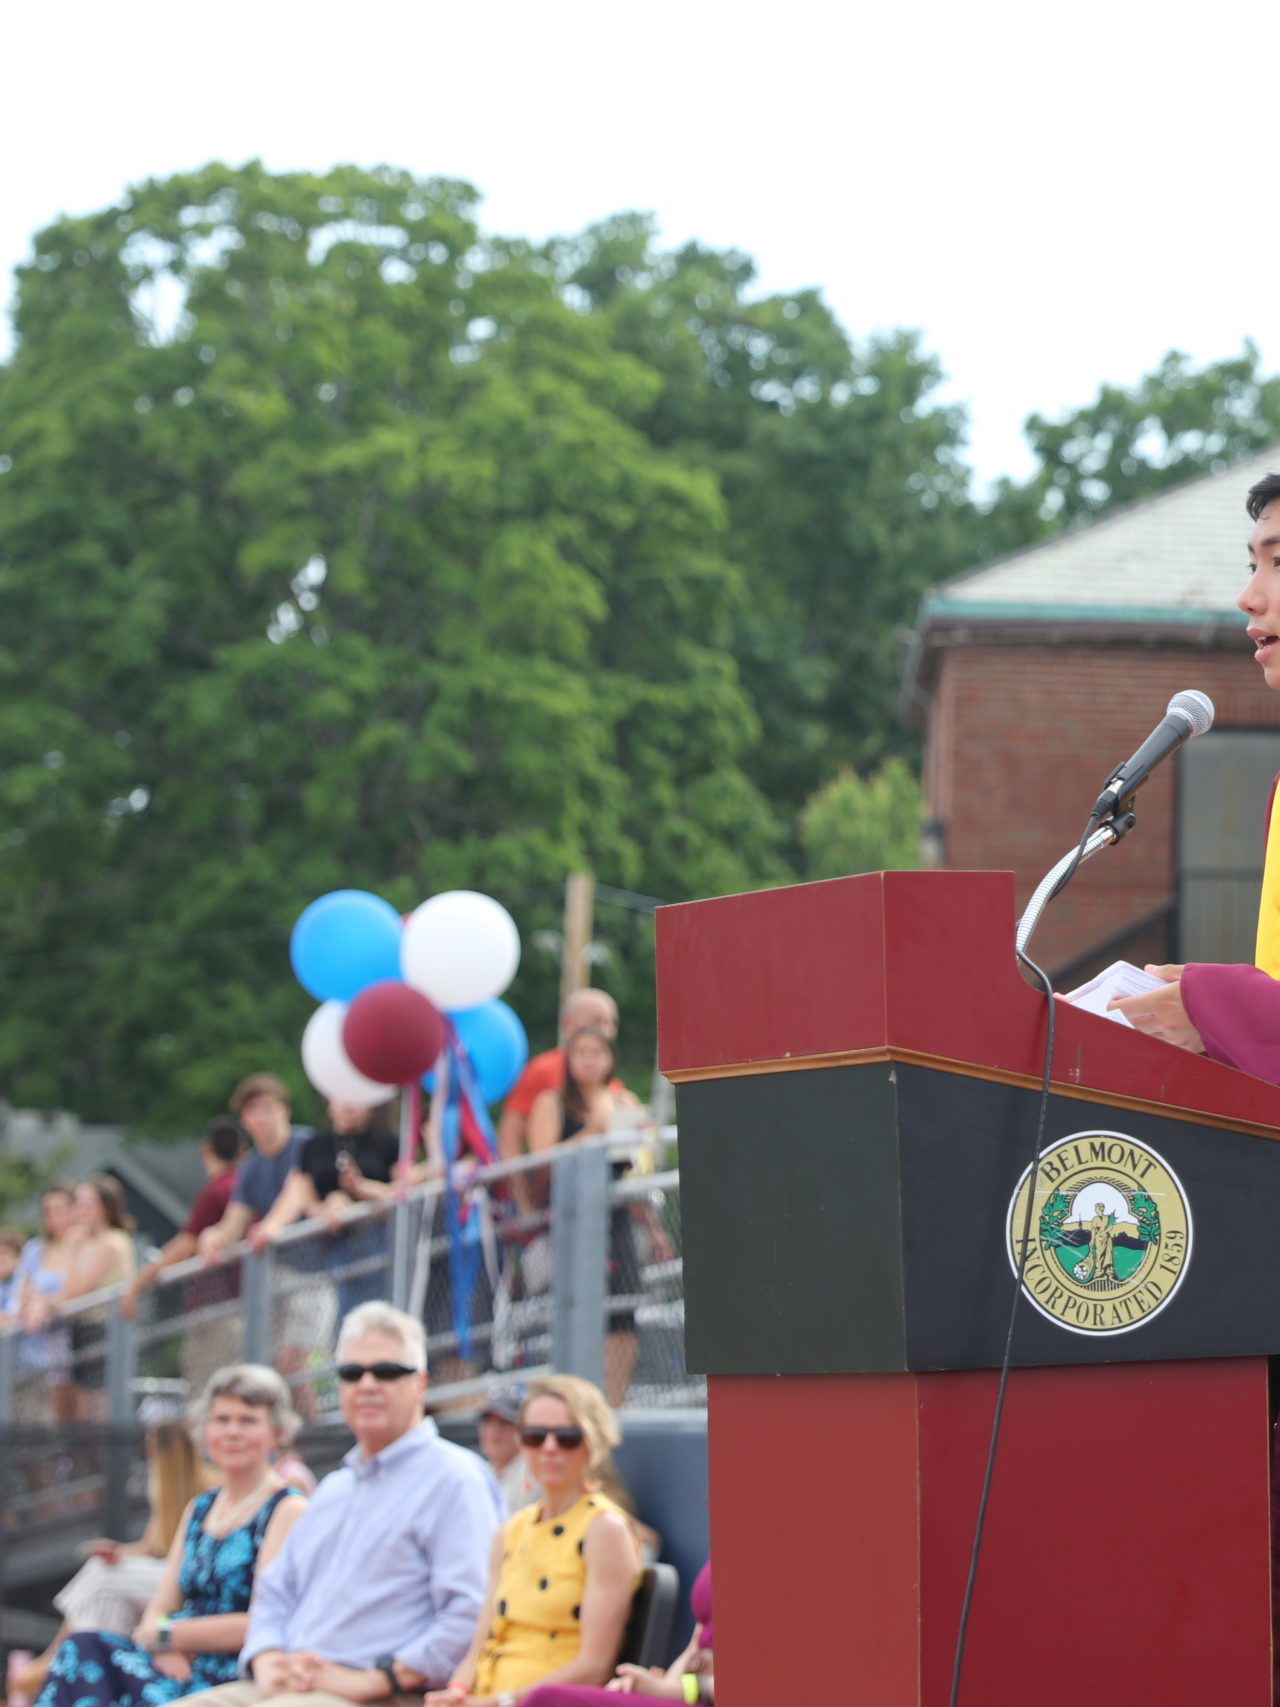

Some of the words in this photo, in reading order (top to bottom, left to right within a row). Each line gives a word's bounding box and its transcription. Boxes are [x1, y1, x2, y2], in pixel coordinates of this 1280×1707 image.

[1040, 1141, 1157, 1183] BELMONT
[1016, 1238, 1163, 1326] INCORPORATED
[1160, 1230, 1185, 1276] 1859
